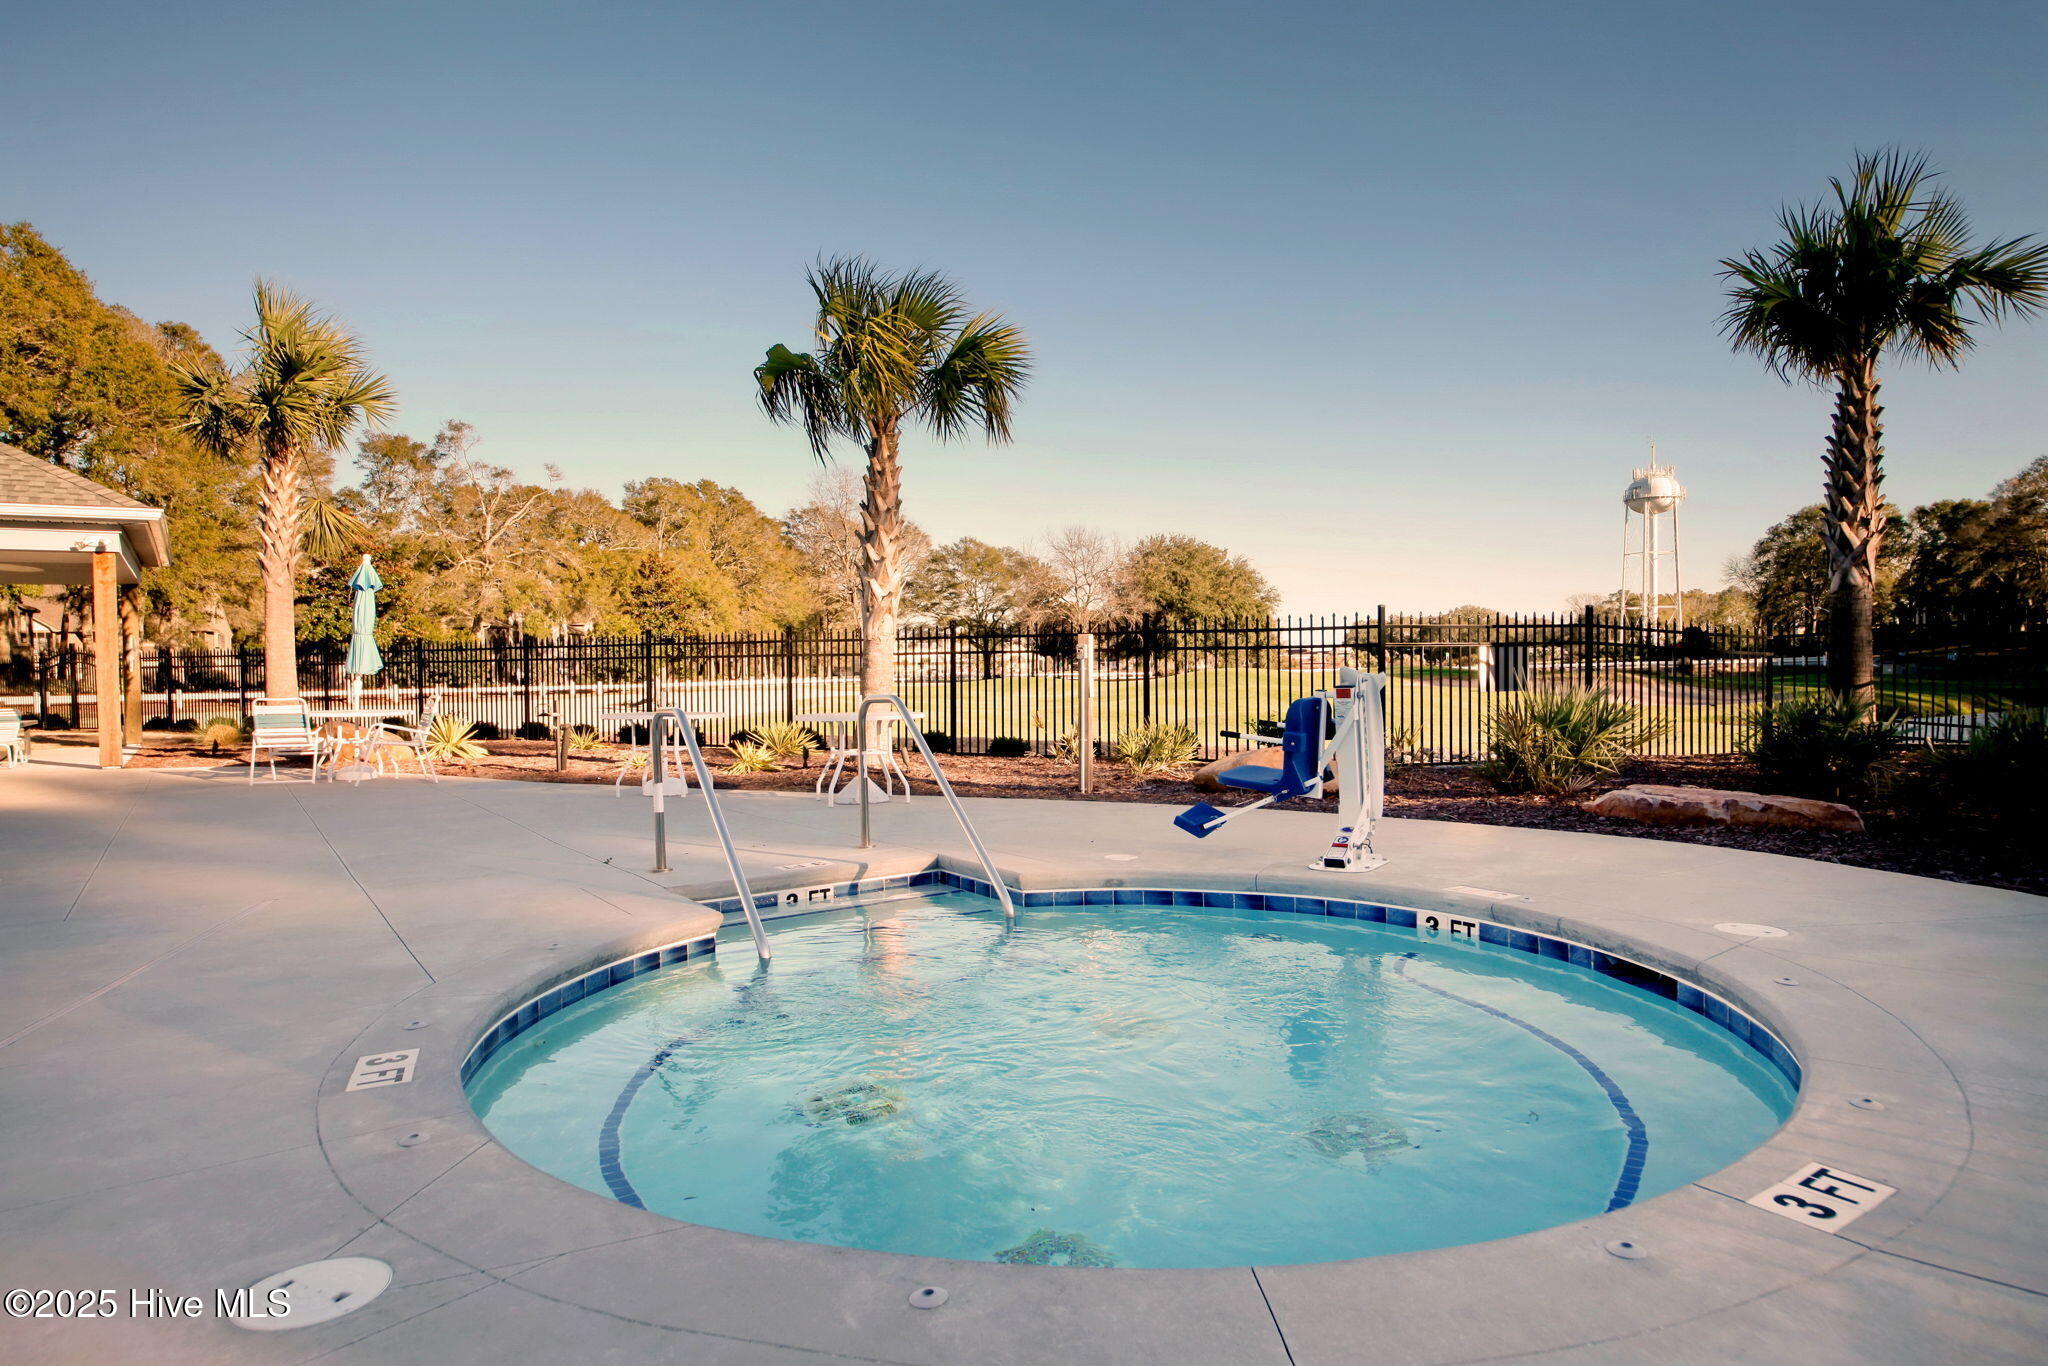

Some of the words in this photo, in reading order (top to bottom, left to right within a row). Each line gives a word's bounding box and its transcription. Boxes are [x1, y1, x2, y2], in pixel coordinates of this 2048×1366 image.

[1425, 915, 1440, 931] 3
[1450, 919, 1476, 938] FT
[365, 1054, 409, 1066] 3
[356, 1067, 406, 1086] FT
[1797, 1167, 1877, 1205] FT
[1773, 1194, 1837, 1220] 3
